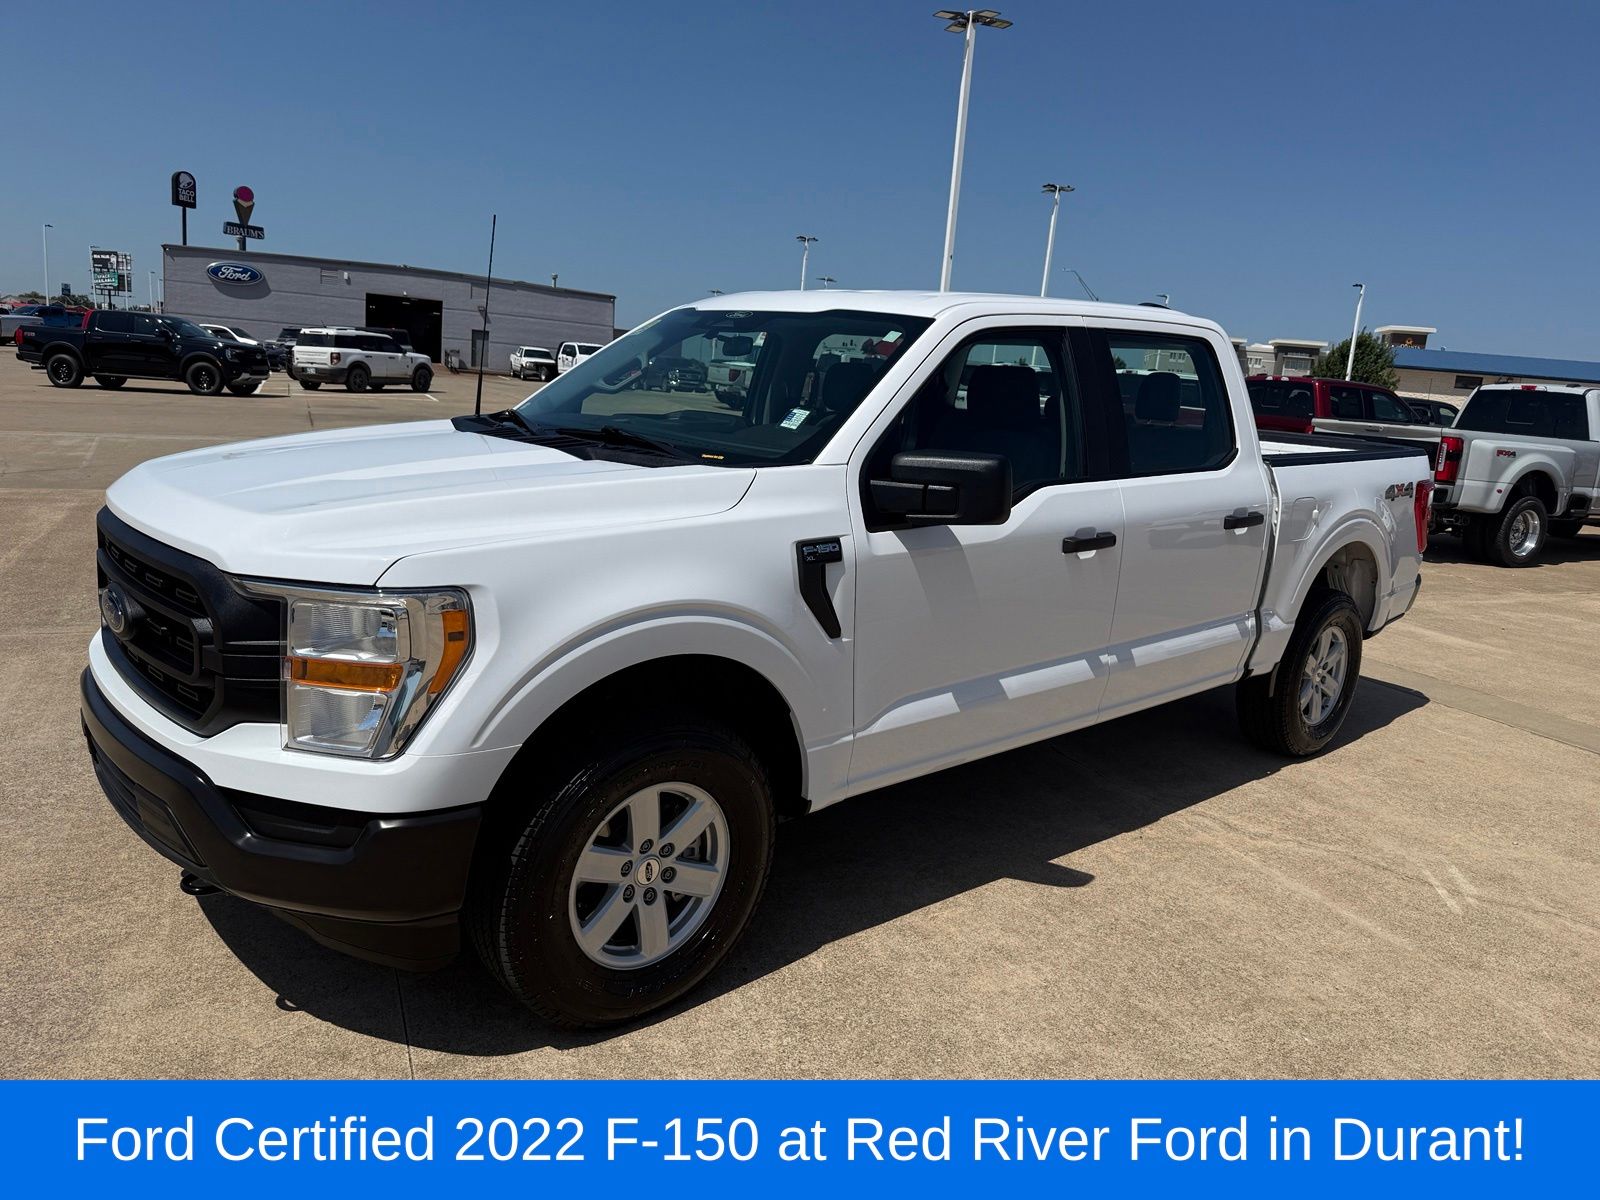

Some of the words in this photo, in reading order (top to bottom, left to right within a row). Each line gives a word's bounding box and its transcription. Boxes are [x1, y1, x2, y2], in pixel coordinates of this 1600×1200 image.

[177, 187, 195, 197] TACO
[178, 194, 195, 203] BELL
[227, 225, 264, 240] BRAUM'S
[217, 265, 251, 281] Ford
[802, 542, 840, 555] F-150
